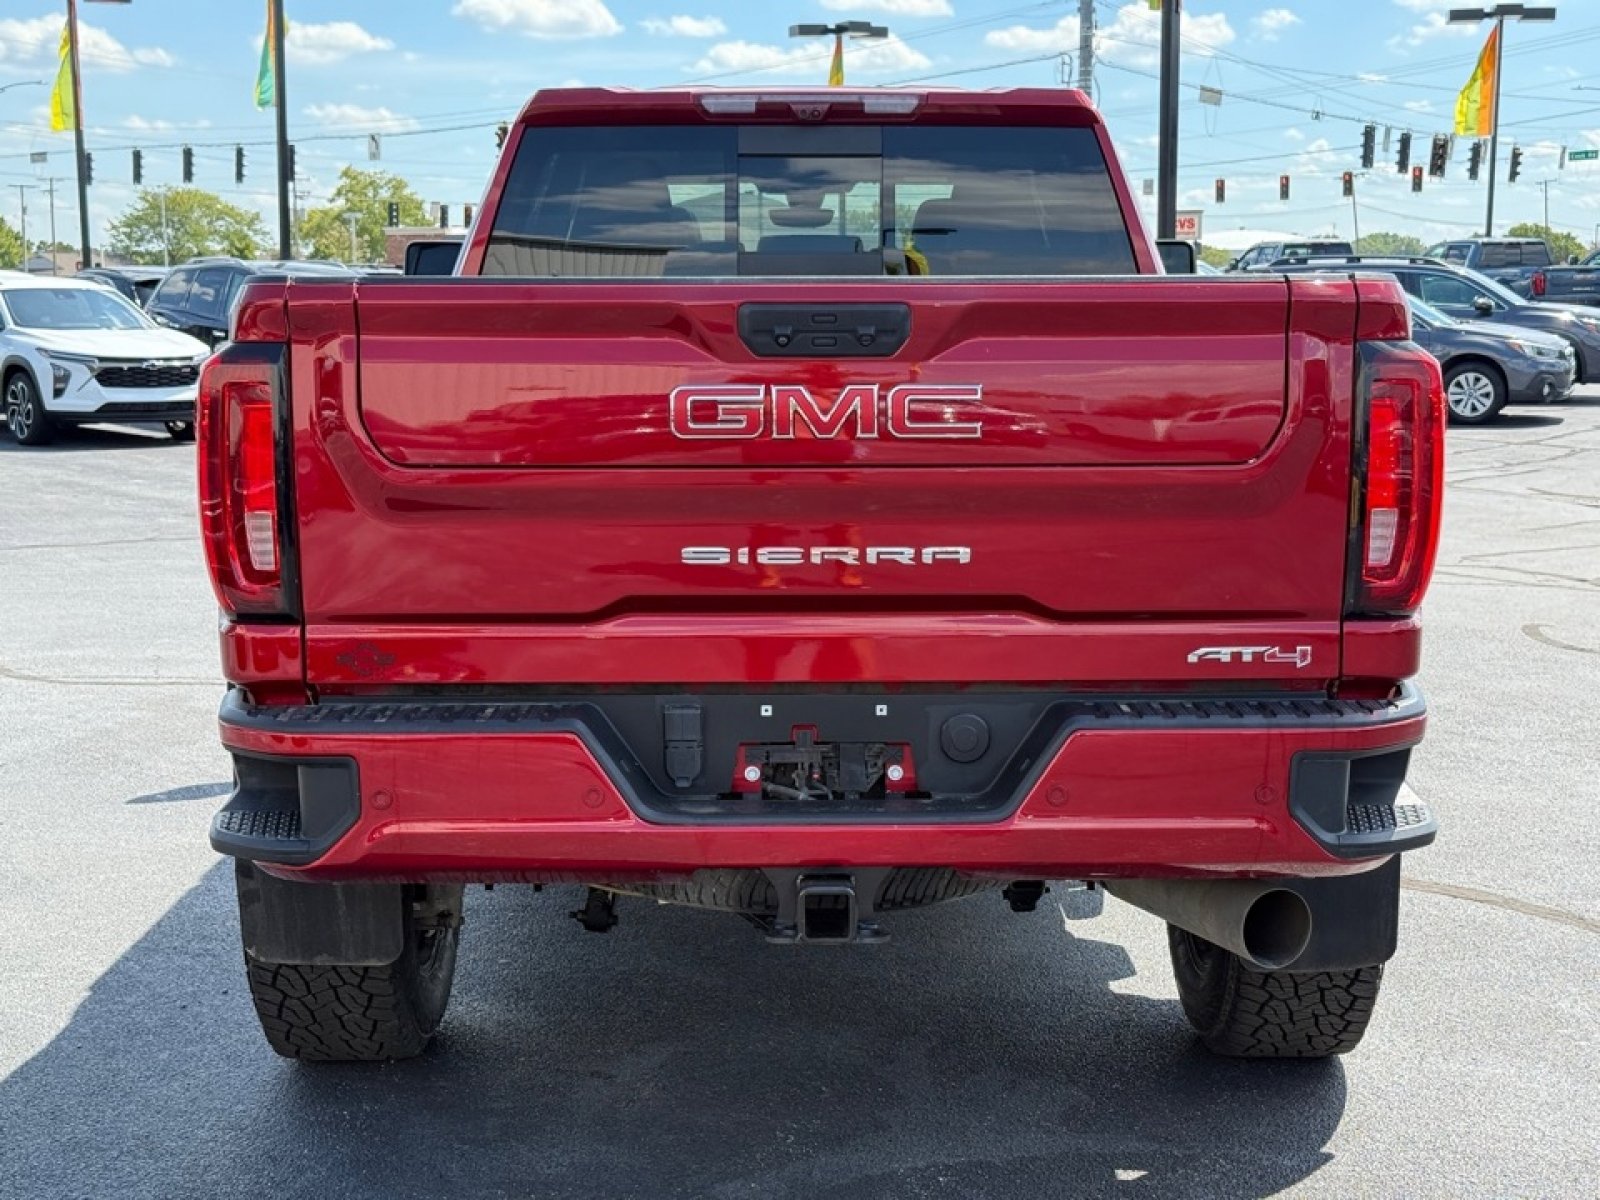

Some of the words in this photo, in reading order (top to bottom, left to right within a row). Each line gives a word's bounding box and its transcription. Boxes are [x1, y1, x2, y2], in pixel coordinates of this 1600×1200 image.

[1175, 217, 1195, 230] VS
[669, 383, 983, 440] GMC
[681, 546, 972, 565] SIERRA
[1187, 645, 1312, 669] AT4
